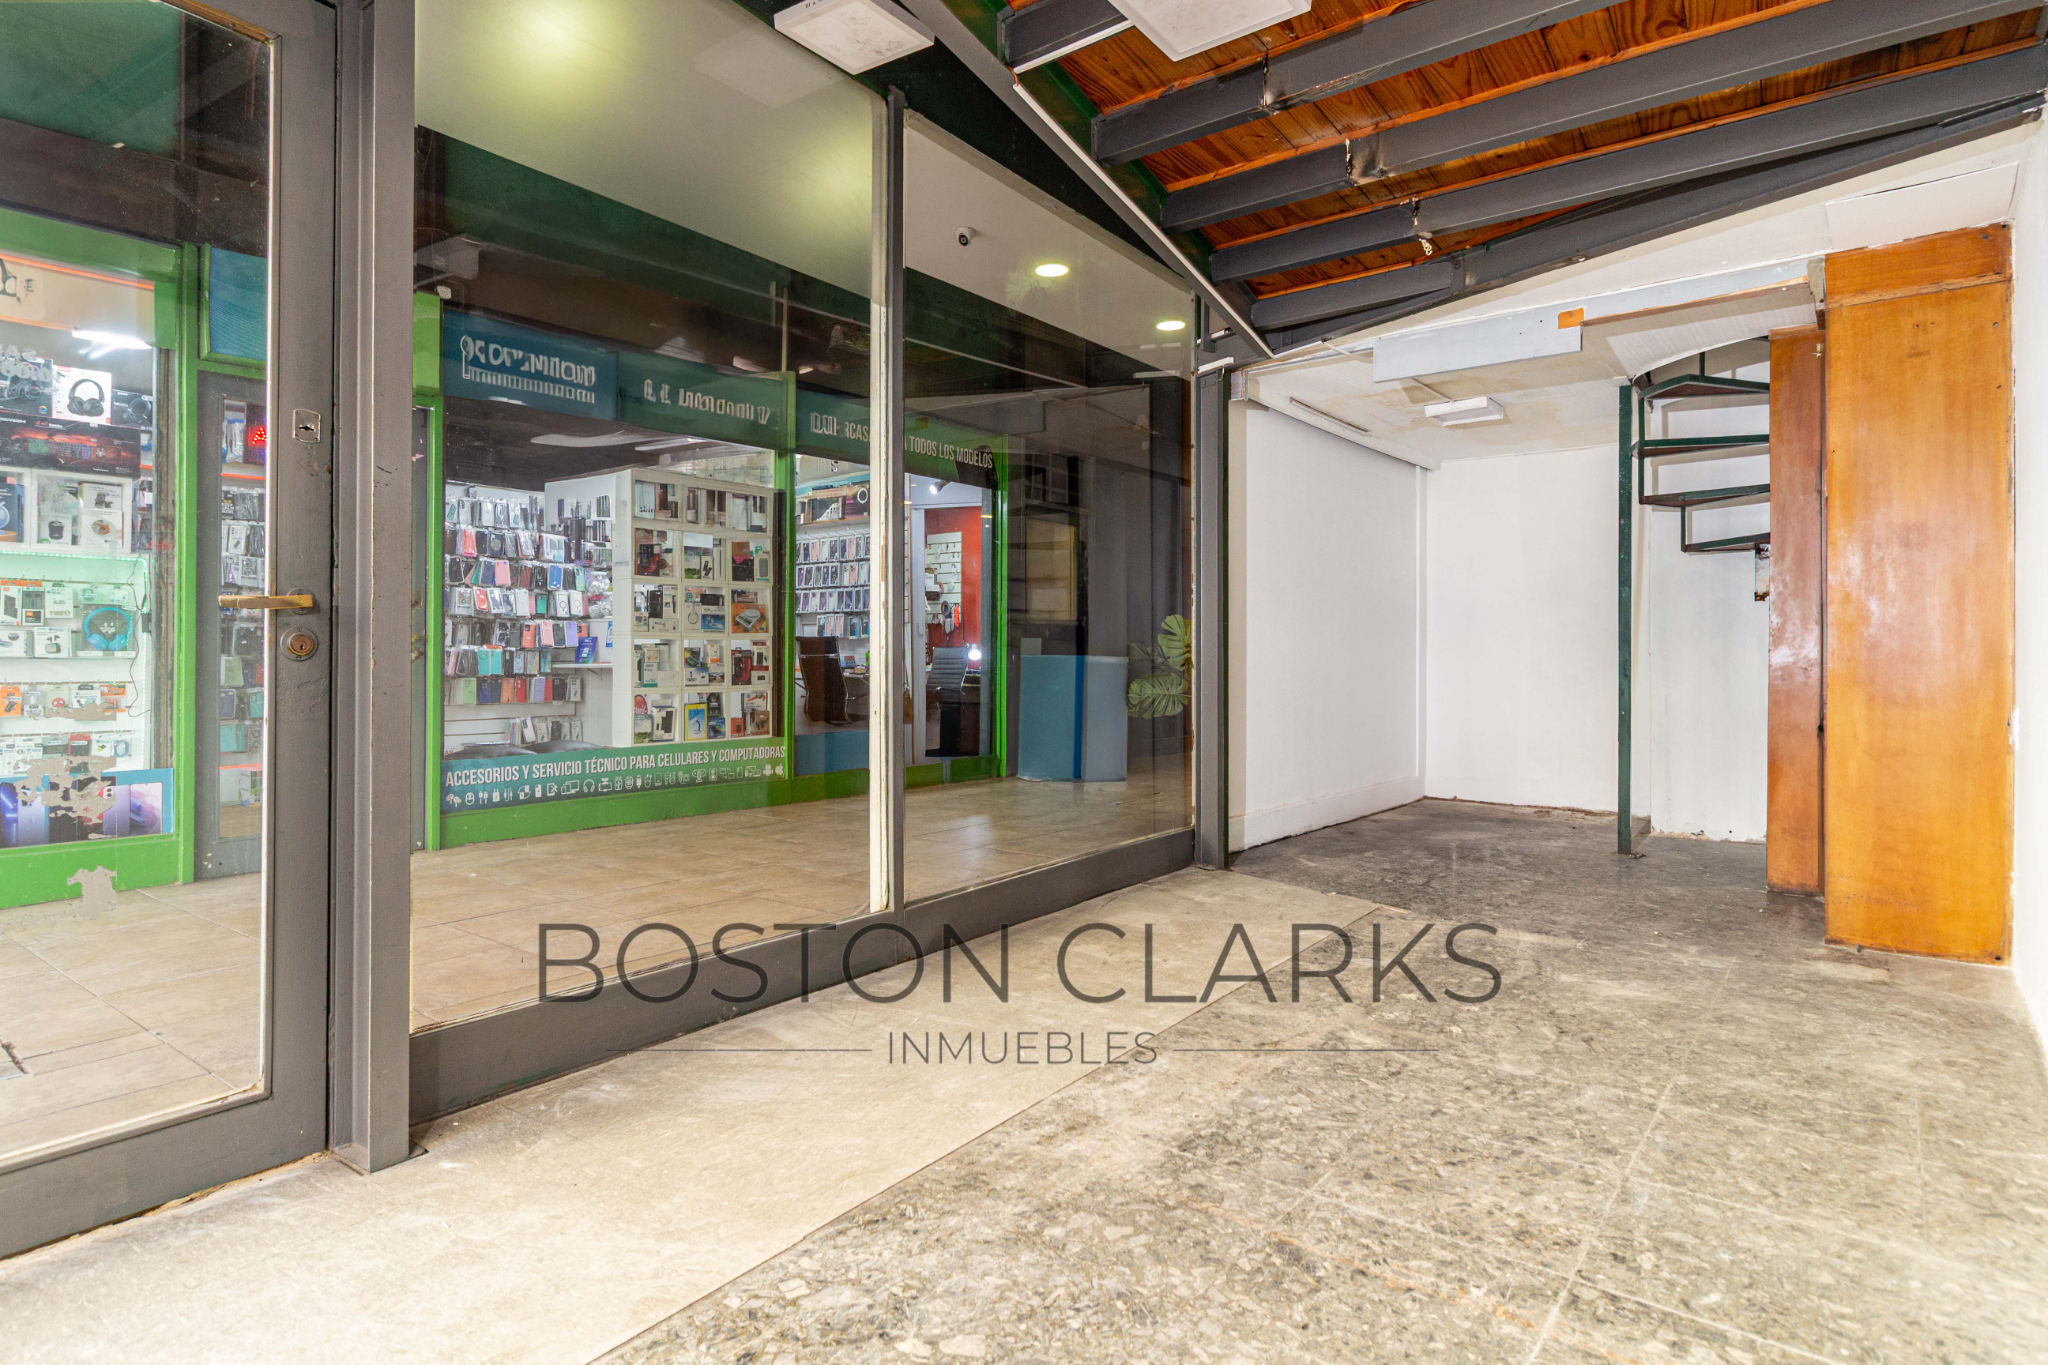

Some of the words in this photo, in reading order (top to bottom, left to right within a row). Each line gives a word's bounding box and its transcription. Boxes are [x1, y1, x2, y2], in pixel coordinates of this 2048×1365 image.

[909, 436, 938, 458] TODOS
[939, 443, 955, 461] LOS
[956, 447, 993, 469] MODELOS
[446, 765, 520, 787] ACCESORIOS
[522, 764, 530, 780] Y
[532, 761, 582, 778] SERVICIO
[584, 756, 628, 774] TÉCNICO
[630, 755, 656, 770] PARA
[657, 751, 709, 768] CELULARES
[711, 750, 718, 763] Y
[719, 745, 786, 762] COMPUTADORAS
